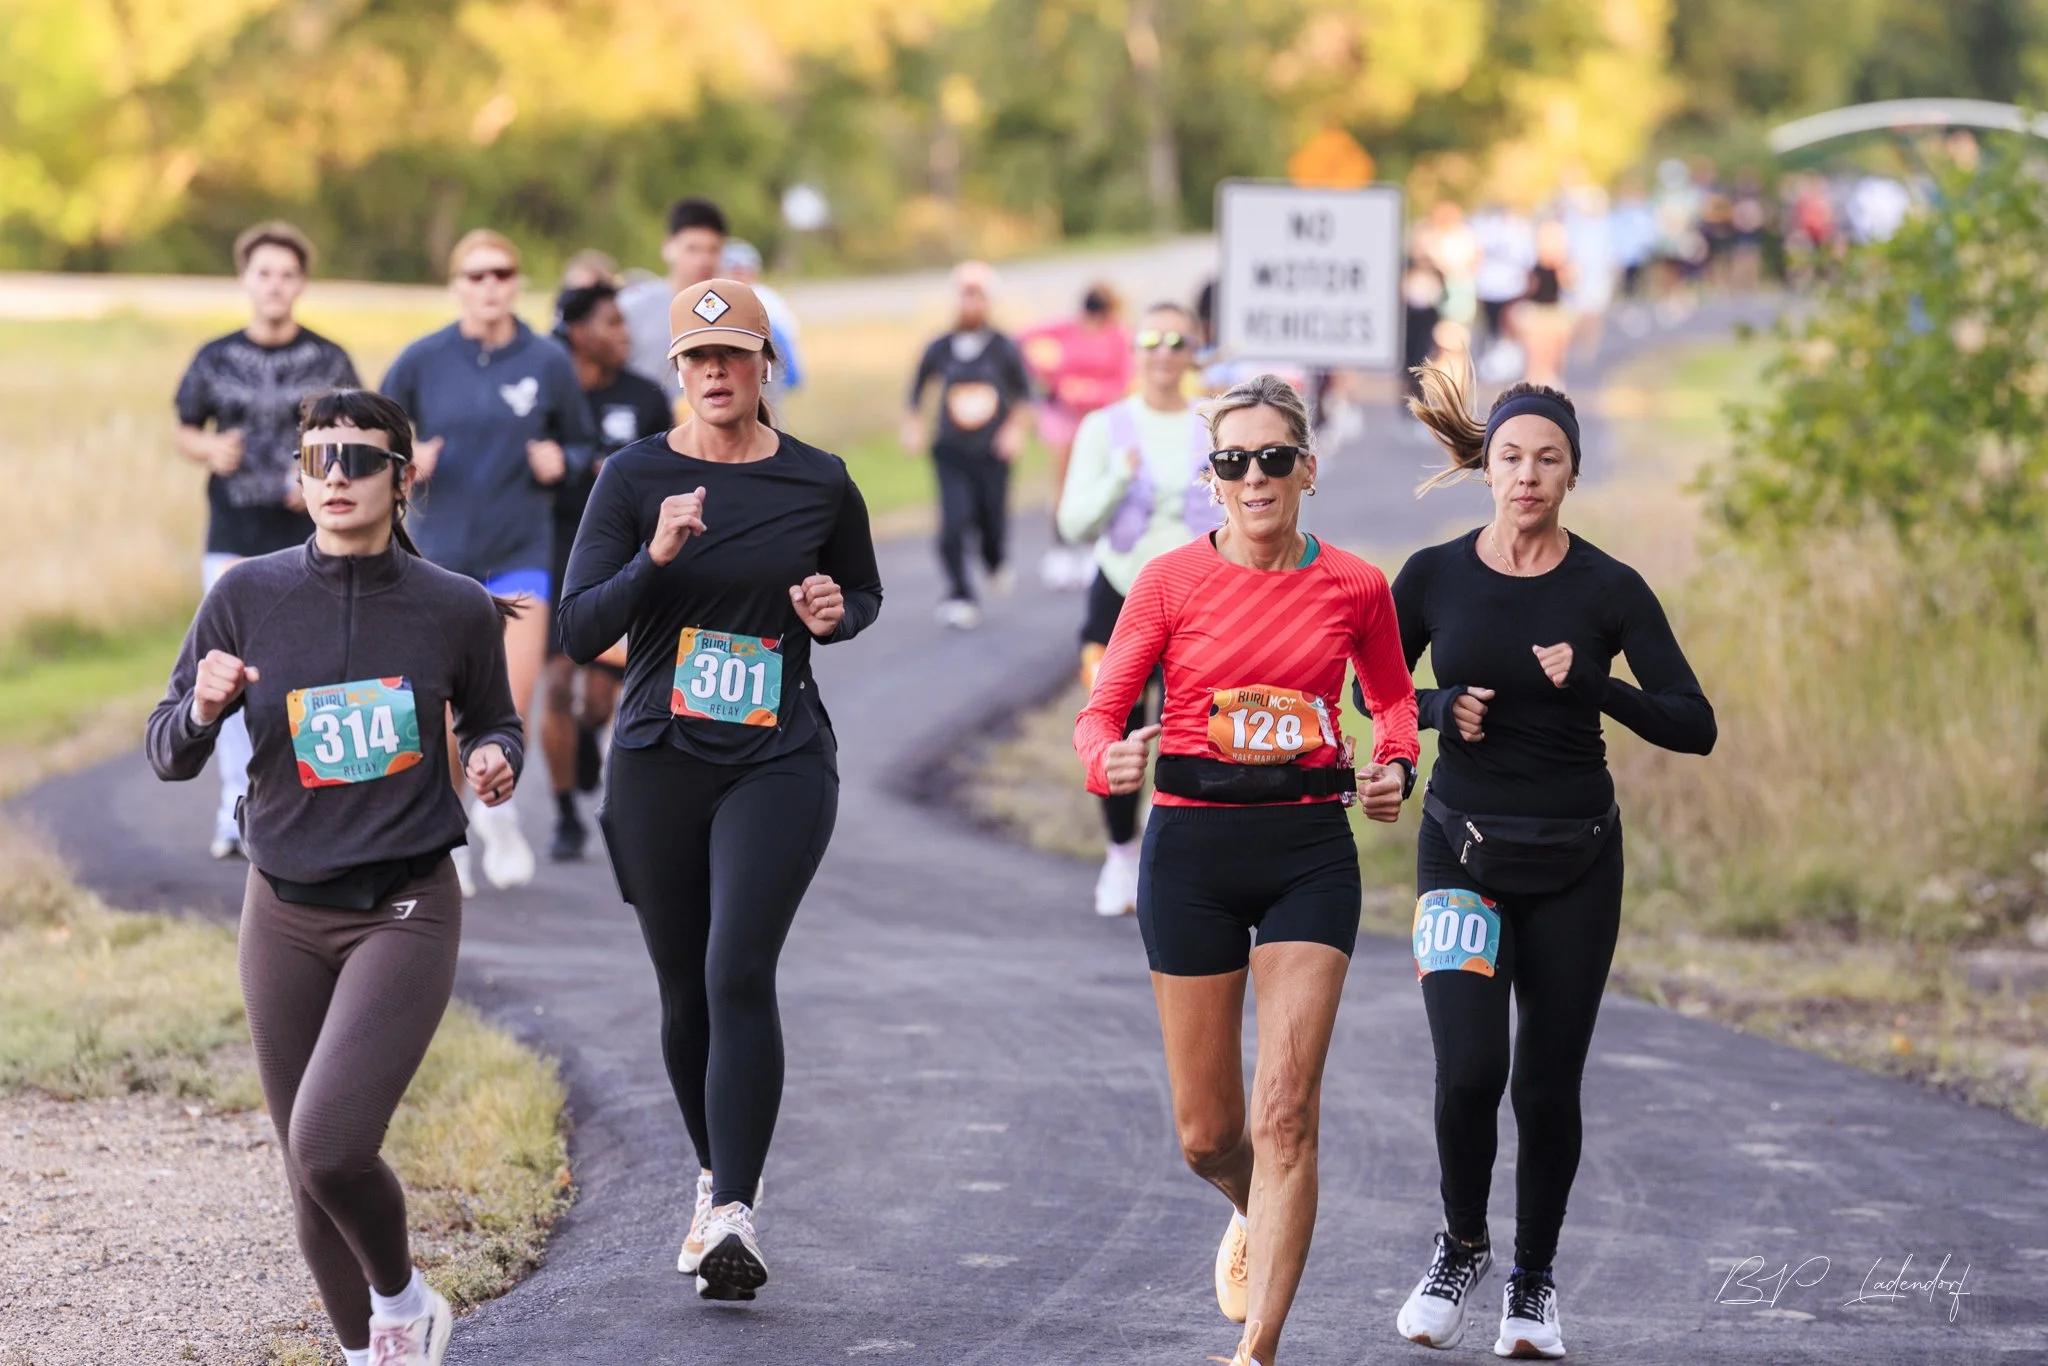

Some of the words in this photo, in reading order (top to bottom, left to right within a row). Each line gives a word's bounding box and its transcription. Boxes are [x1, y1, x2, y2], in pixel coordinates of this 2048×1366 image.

[1287, 210, 1336, 244] NO
[1252, 259, 1369, 292] MOTOR
[1243, 308, 1375, 344] VEHICLES
[690, 654, 765, 705] 301
[709, 703, 740, 717] RELAY
[310, 704, 400, 764] 314
[1227, 708, 1304, 751] 128
[343, 762, 378, 777] RELAY
[1232, 752, 1252, 761] HALF
[1417, 909, 1487, 958] 300
[1430, 955, 1456, 965] RELAY
